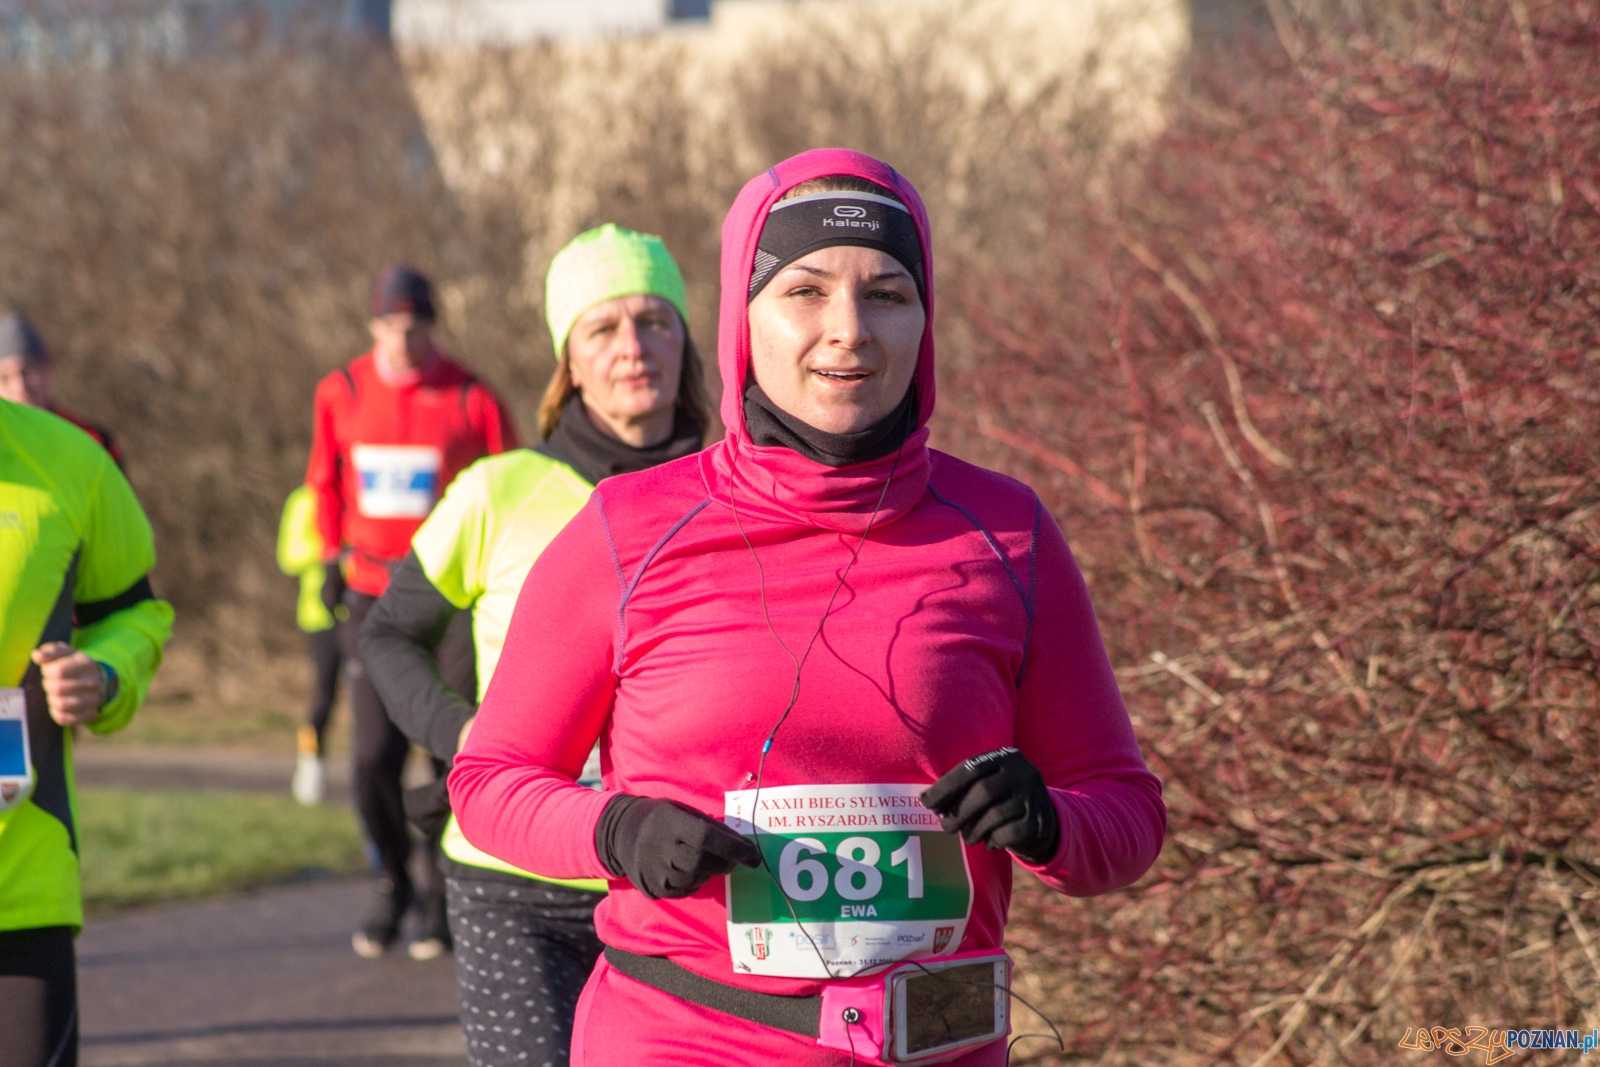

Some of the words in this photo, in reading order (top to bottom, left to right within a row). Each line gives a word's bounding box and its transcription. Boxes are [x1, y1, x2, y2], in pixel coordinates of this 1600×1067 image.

[823, 218, 880, 231] Kalenji
[760, 799, 804, 811] XXXII
[808, 797, 846, 809] BIEG
[849, 796, 925, 809] SYLWESTR
[767, 815, 792, 828] IM.
[796, 814, 878, 827] RYSZARDA
[779, 836, 924, 902] 681
[840, 904, 878, 918] EWA
